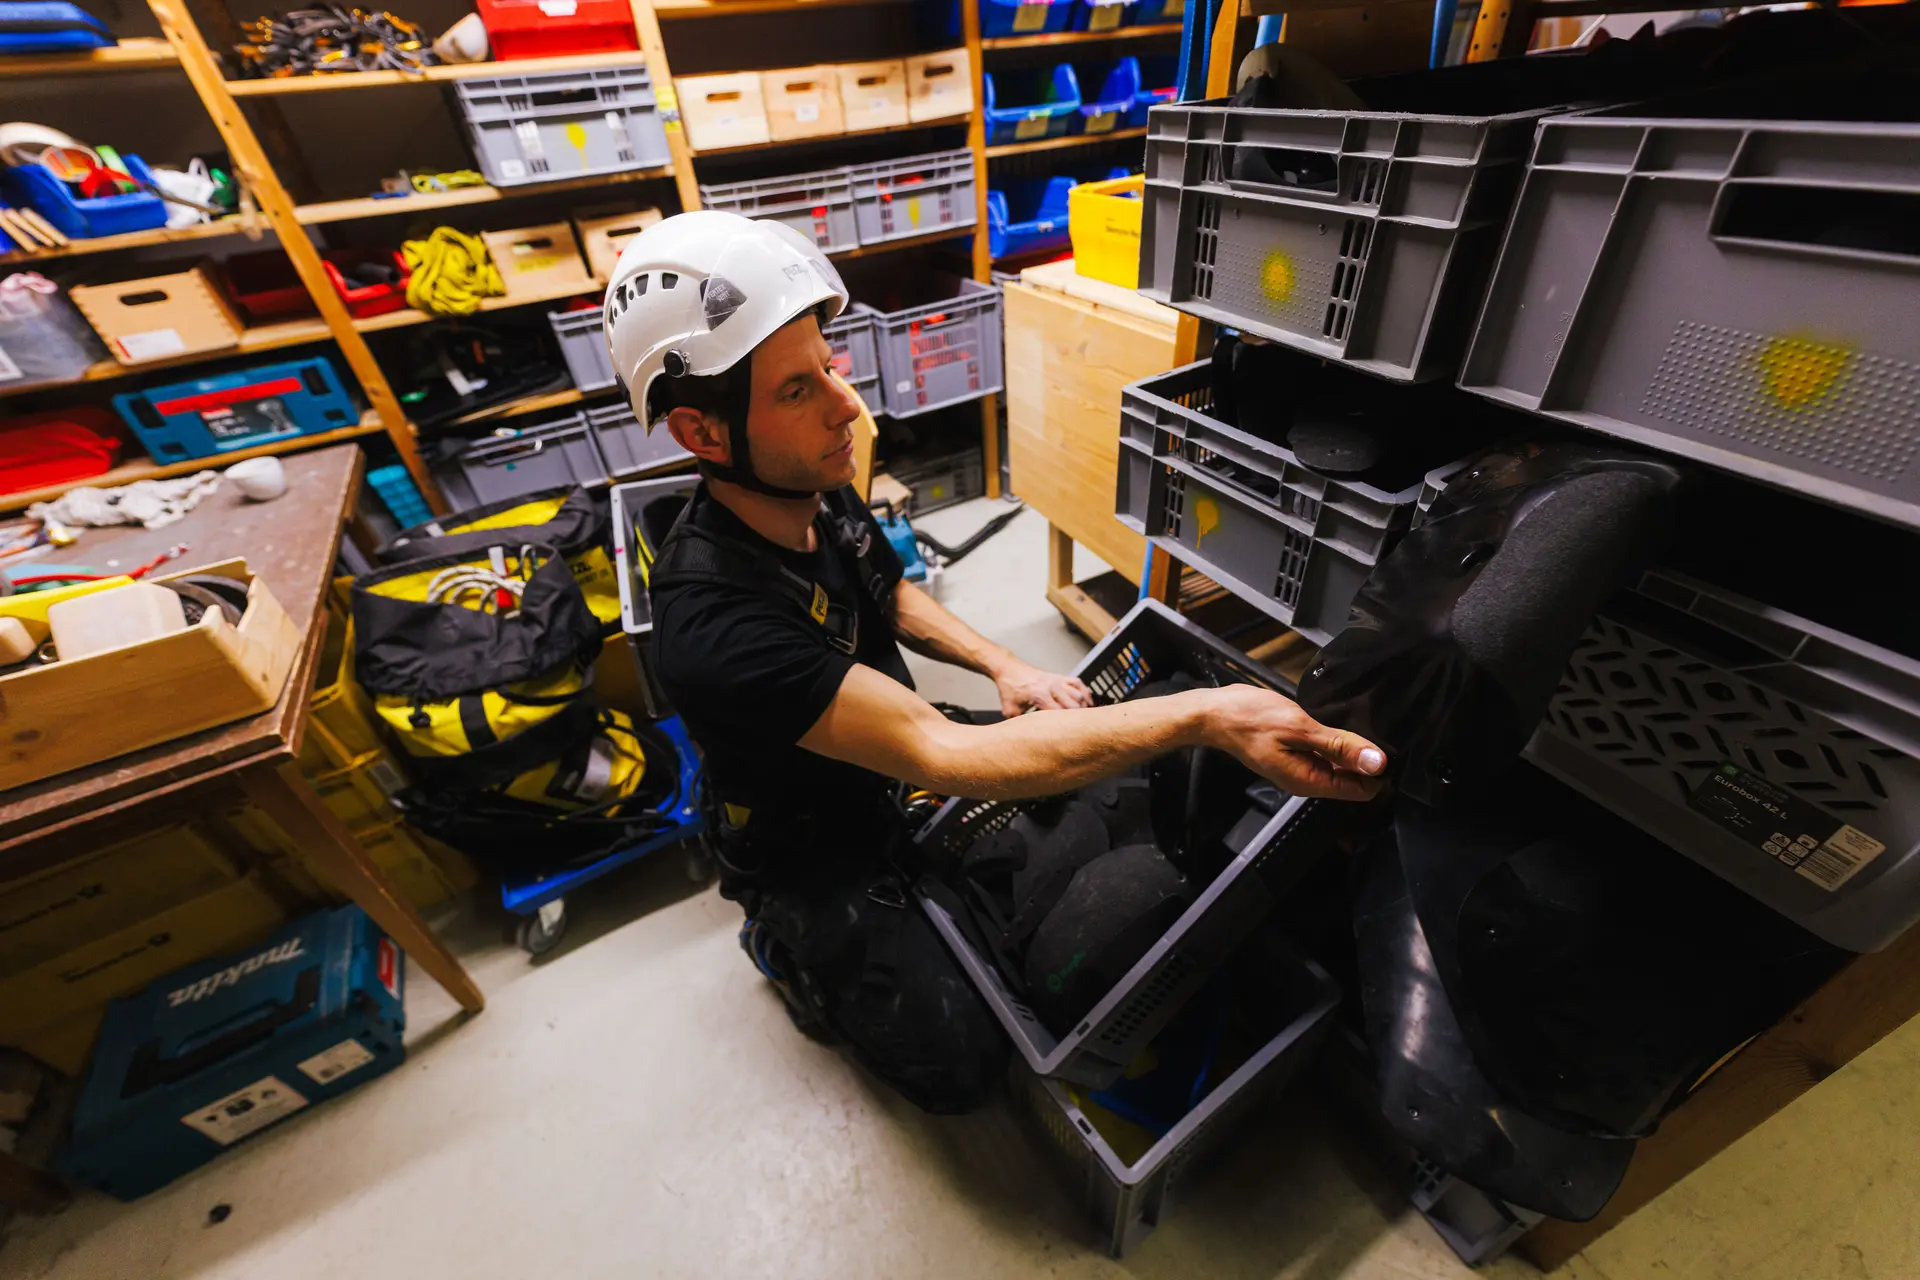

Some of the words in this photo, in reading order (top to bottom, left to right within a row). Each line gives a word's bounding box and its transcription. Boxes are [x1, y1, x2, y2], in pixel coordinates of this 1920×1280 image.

[707, 285, 727, 299] VERTEX
[717, 291, 731, 302] VENT
[1714, 774, 1760, 804] Eurobox
[1762, 801, 1780, 814] 42
[1779, 811, 1788, 820] L
